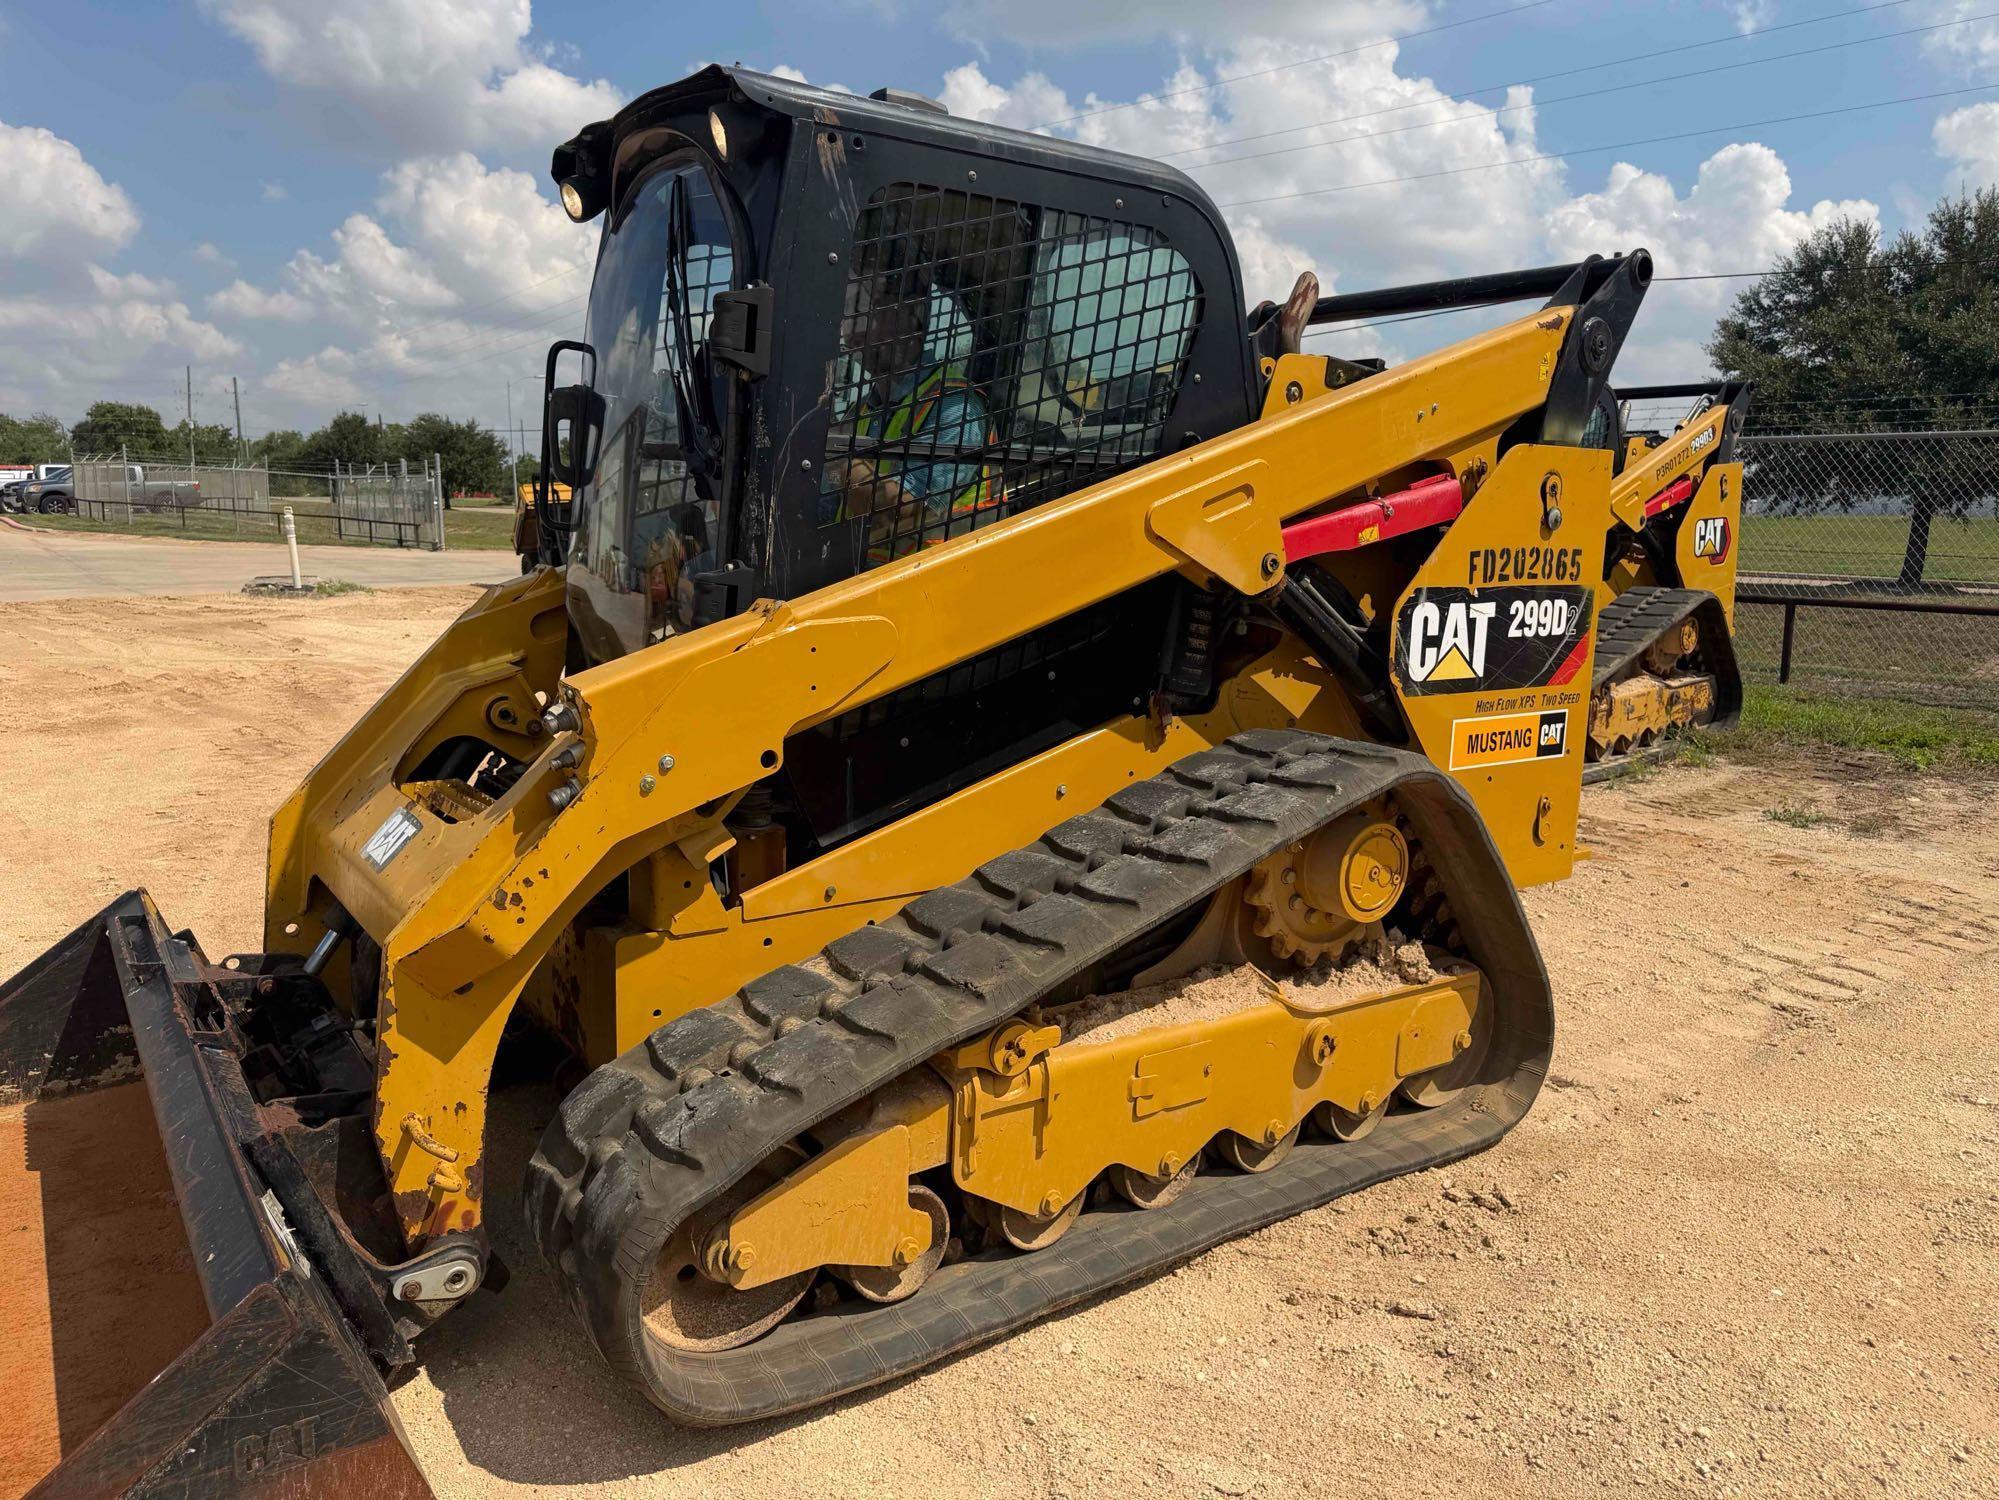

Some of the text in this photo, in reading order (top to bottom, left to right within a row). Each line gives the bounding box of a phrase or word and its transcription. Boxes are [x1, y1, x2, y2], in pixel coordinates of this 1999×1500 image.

[1691, 428, 1713, 453] 299D3
[1656, 447, 1690, 480] P3R01272
[1695, 519, 1724, 556] CAT
[1469, 547, 1582, 584] FD202865
[1508, 599, 1579, 638] 299D2
[1408, 601, 1496, 682] CAT
[1517, 695, 1536, 709] XPS
[1467, 728, 1532, 754] MUSTANG
[1540, 723, 1564, 746] CAT
[367, 813, 417, 866] CAT
[234, 1415, 320, 1481] CAT
